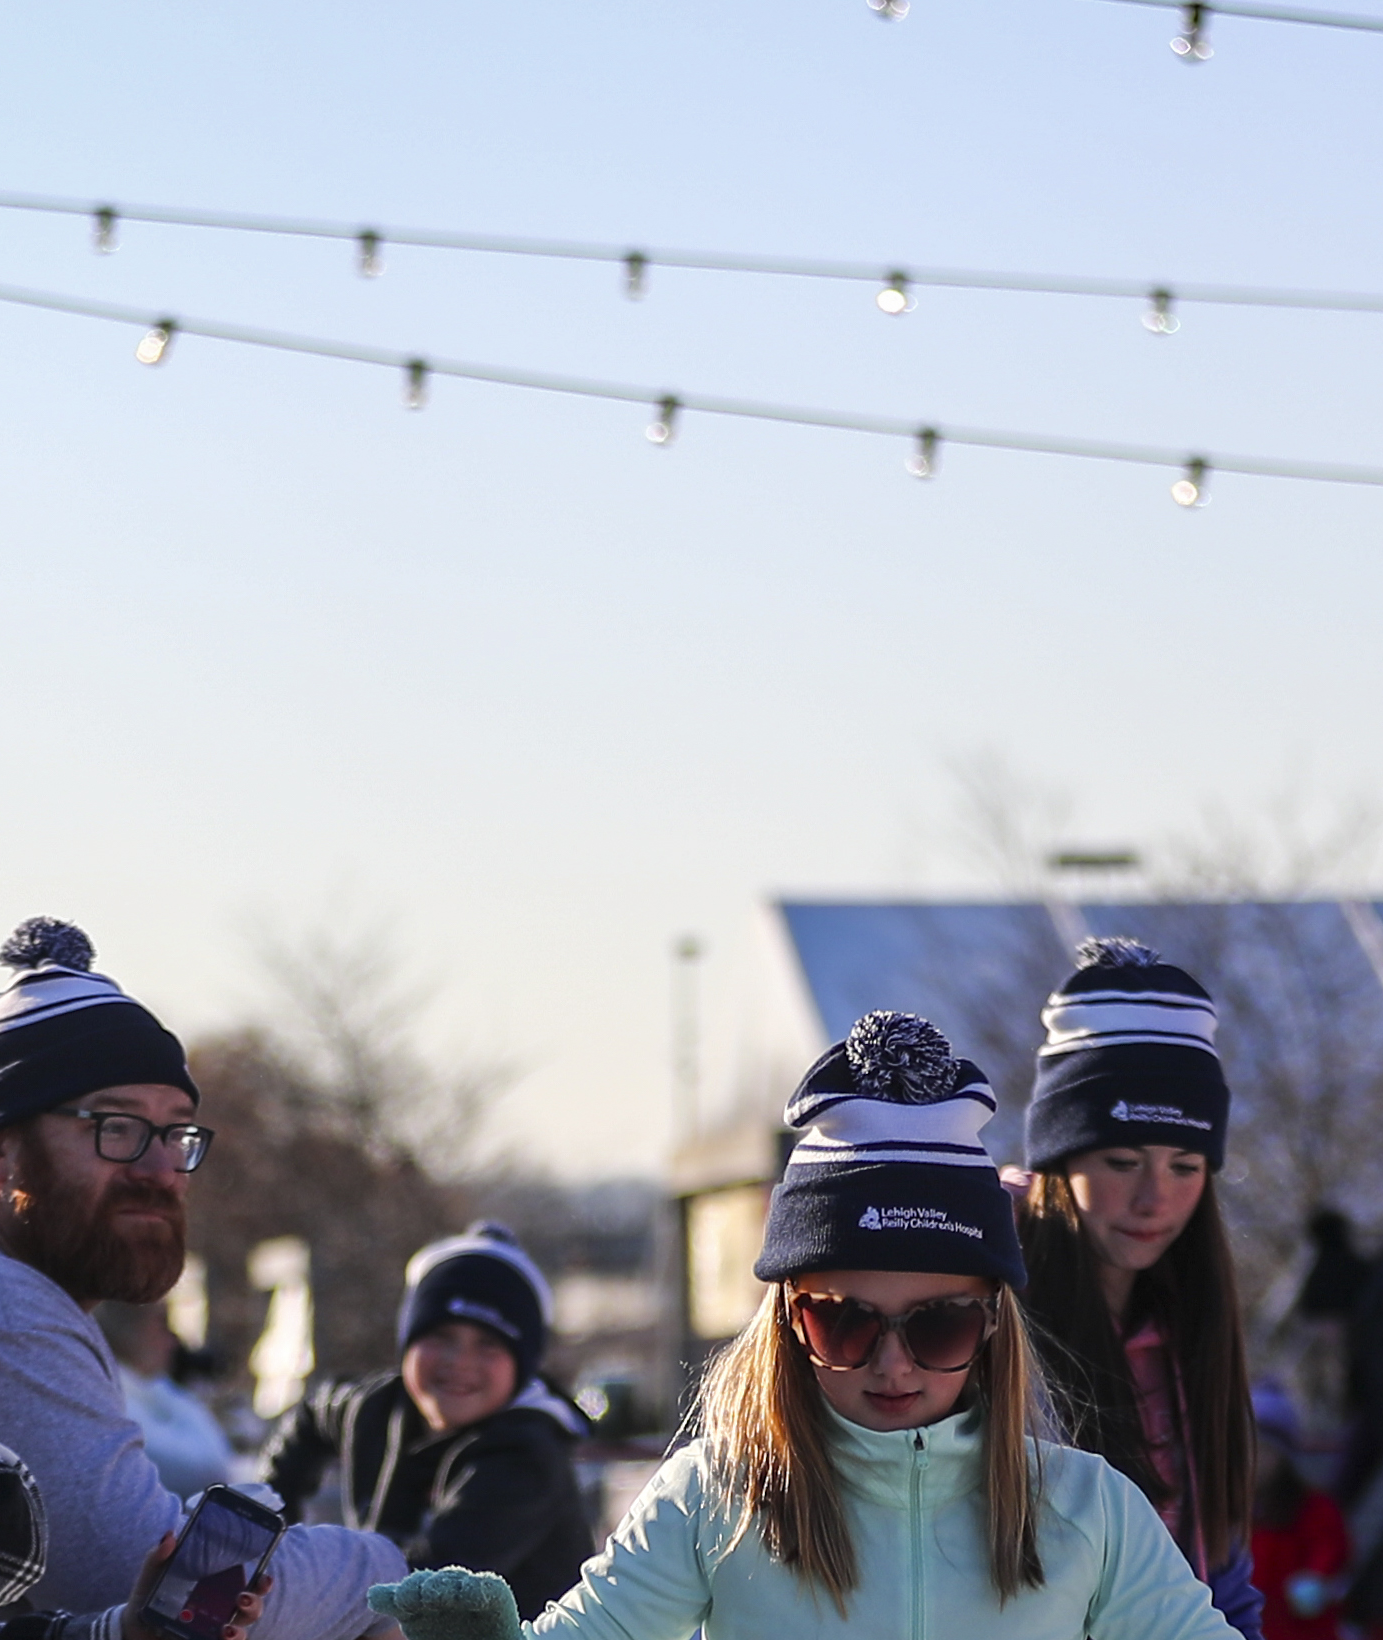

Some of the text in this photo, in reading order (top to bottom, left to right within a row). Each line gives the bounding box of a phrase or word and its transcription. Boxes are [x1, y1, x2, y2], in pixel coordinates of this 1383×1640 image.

[881, 1207, 947, 1222] Lehigh Valley
[882, 1218, 983, 1239] Reilly Children's Hospital
